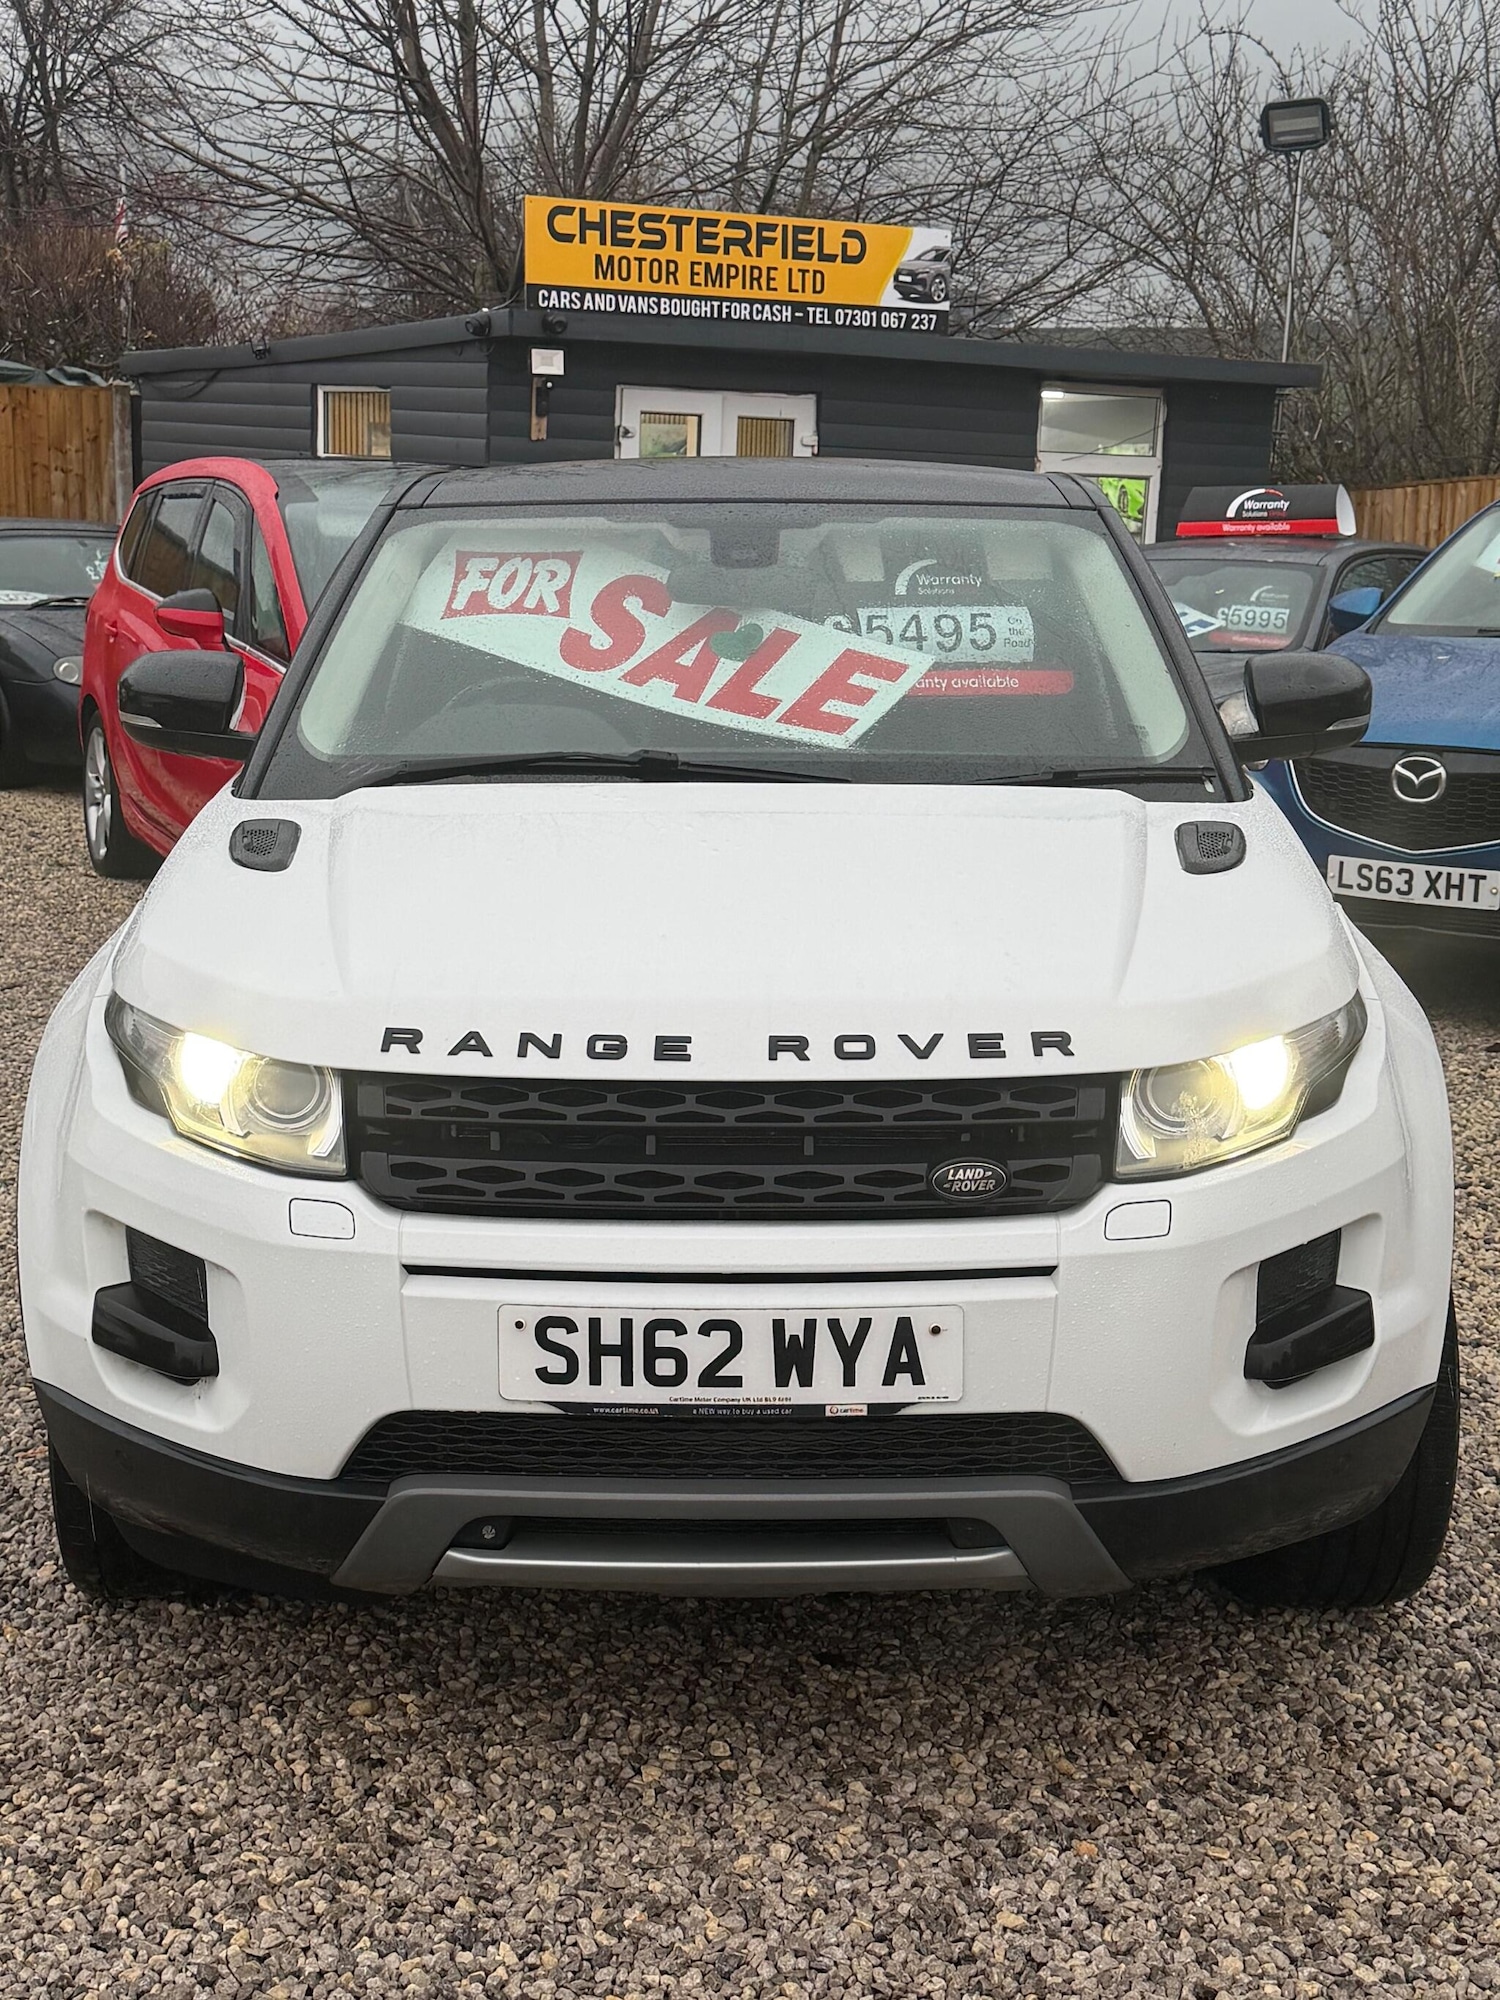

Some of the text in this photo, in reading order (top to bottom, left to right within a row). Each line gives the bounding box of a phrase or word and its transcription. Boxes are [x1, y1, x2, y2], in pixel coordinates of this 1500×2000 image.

[547, 205, 867, 265] CHESTERFIELD
[594, 253, 825, 295] MOTOR EMPIRE LTD
[538, 289, 582, 310] CARS
[583, 292, 616, 312] AND
[618, 294, 659, 315] VANS
[659, 297, 721, 318] BOUGHT
[722, 301, 751, 320] FOR
[752, 303, 792, 322] CASH
[807, 307, 832, 325] TEL
[835, 308, 877, 327] 07301
[881, 311, 907, 329] 067
[911, 313, 937, 331] 237
[1243, 499, 1290, 511] Warranty
[1222, 522, 1256, 533] Warranty
[915, 573, 983, 588] Warranty
[452, 557, 910, 736] FOR SALE
[952, 675, 1020, 688] available
[1337, 861, 1487, 903] LS63 XHT
[380, 1027, 1075, 1061] RANGE ROVER
[947, 1168, 984, 1181] LAND
[951, 1179, 996, 1192] ROVER
[534, 1315, 926, 1388] SH62 WYA
